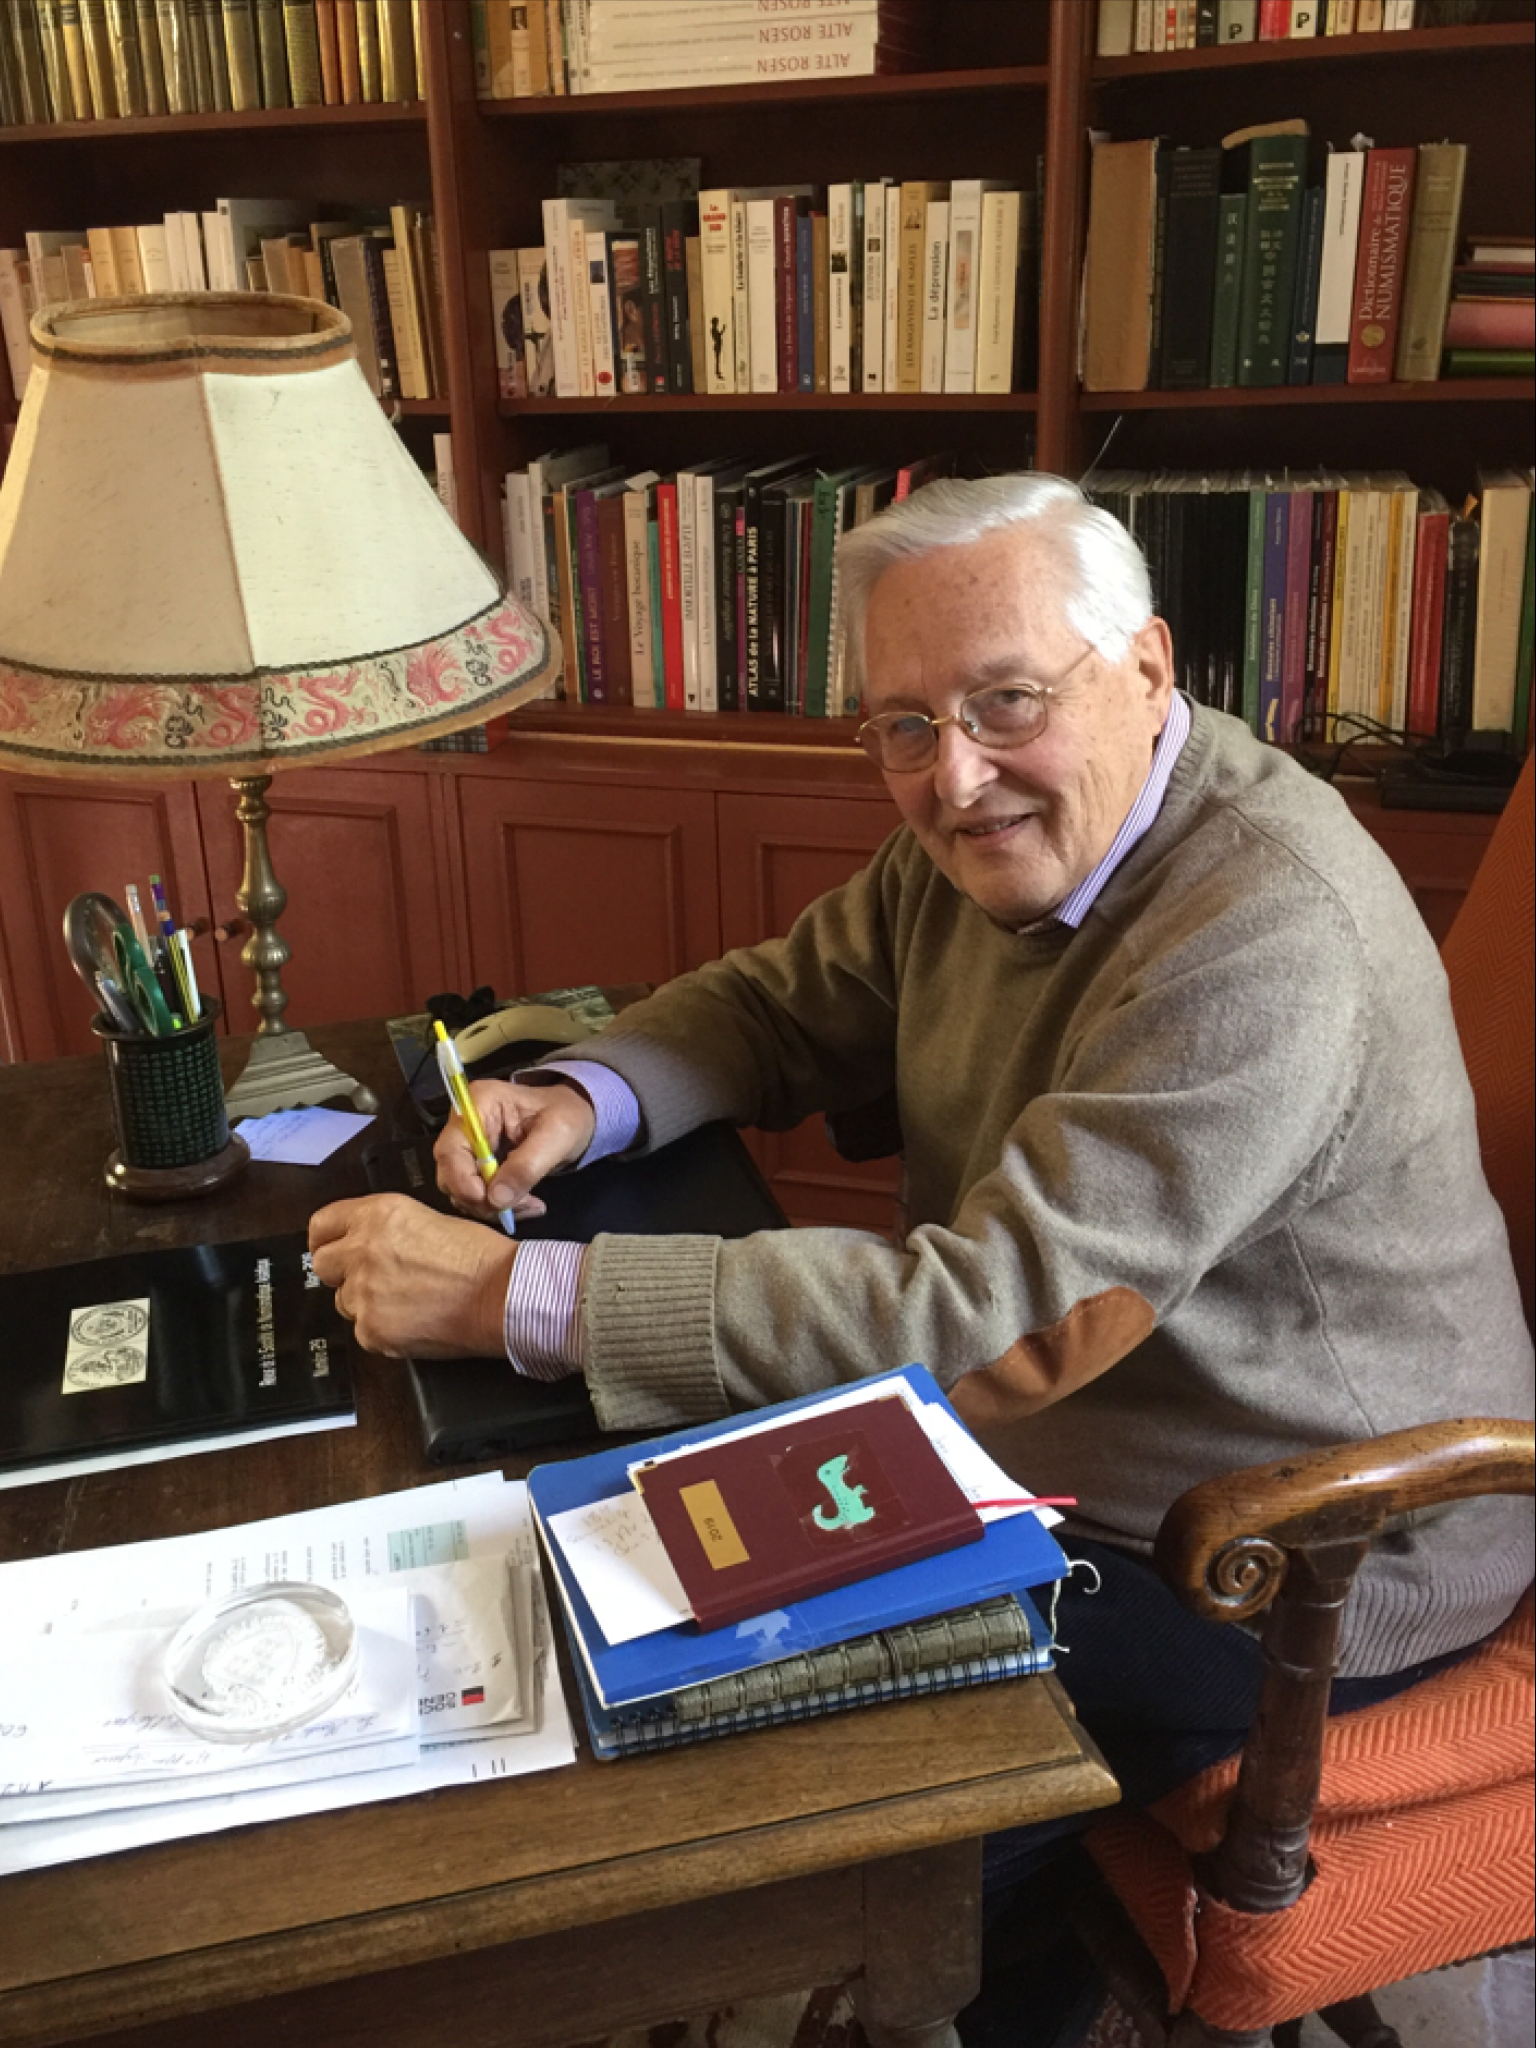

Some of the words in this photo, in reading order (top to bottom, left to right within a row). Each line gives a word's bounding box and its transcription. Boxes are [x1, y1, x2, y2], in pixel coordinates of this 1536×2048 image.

[759, 25, 812, 43] ROSEN
[818, 22, 854, 39] ALTE
[757, 56, 809, 74] ROSEN
[815, 53, 850, 70] ALTE
[1375, 163, 1408, 321] NUMISMATIQUE
[928, 241, 942, 303] dépression
[1357, 227, 1382, 320] Dictionnaire
[927, 306, 939, 321] La
[905, 352, 914, 369] LES
[746, 526, 759, 565] PARIS
[629, 540, 645, 596] botanique
[747, 576, 759, 626] NATURE
[633, 599, 647, 638] Voyage
[747, 627, 759, 639] la
[634, 642, 645, 656] Le
[748, 641, 759, 656] de
[748, 659, 759, 698] ATLAS
[702, 1517, 724, 1543] 2019
